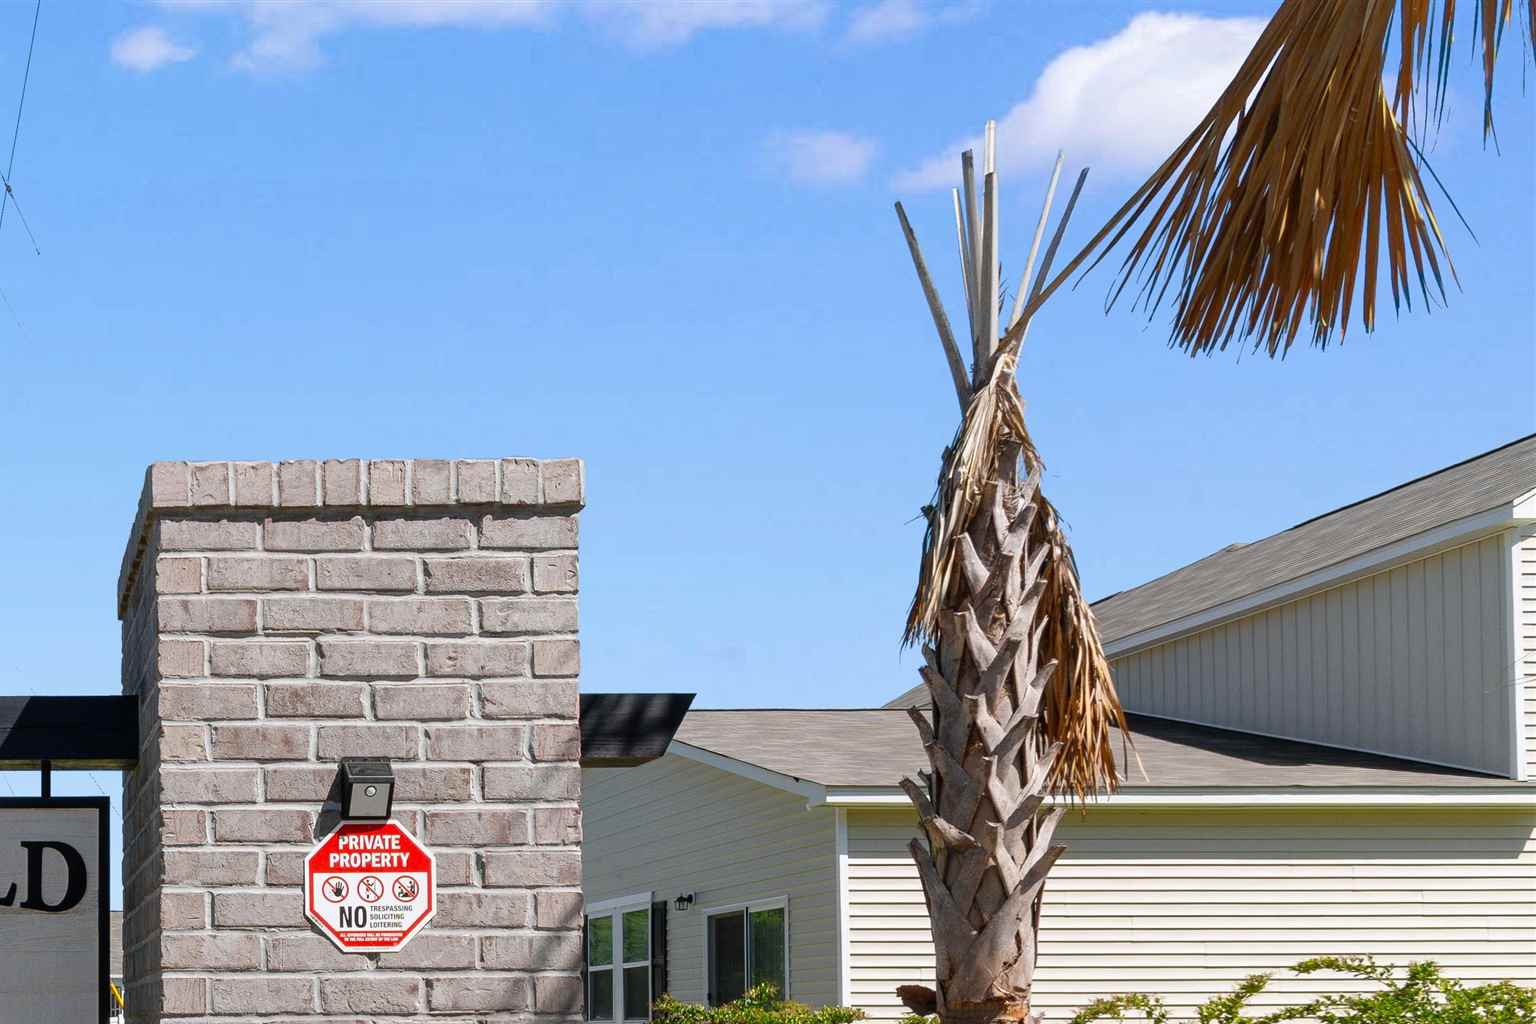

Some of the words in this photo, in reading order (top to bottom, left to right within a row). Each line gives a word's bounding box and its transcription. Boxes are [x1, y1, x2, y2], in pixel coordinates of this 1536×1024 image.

[338, 834, 401, 850] PRIVATE
[329, 852, 410, 868] PROPERTY
[339, 906, 368, 928] NO
